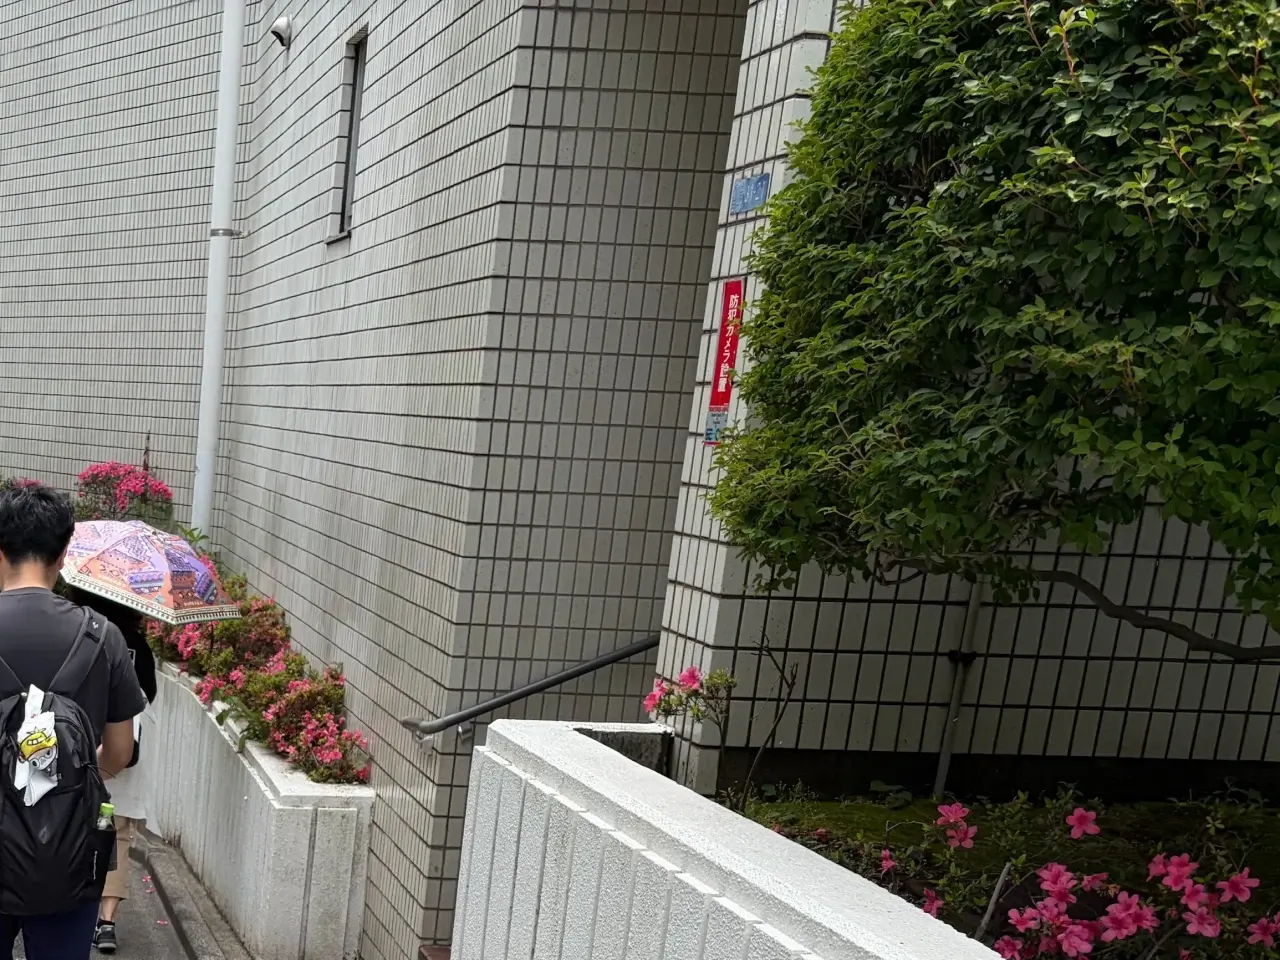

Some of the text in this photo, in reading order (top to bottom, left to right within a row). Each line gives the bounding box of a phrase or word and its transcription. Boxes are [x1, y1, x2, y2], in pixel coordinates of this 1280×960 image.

[717, 293, 740, 393] 防犯カメラ設置
